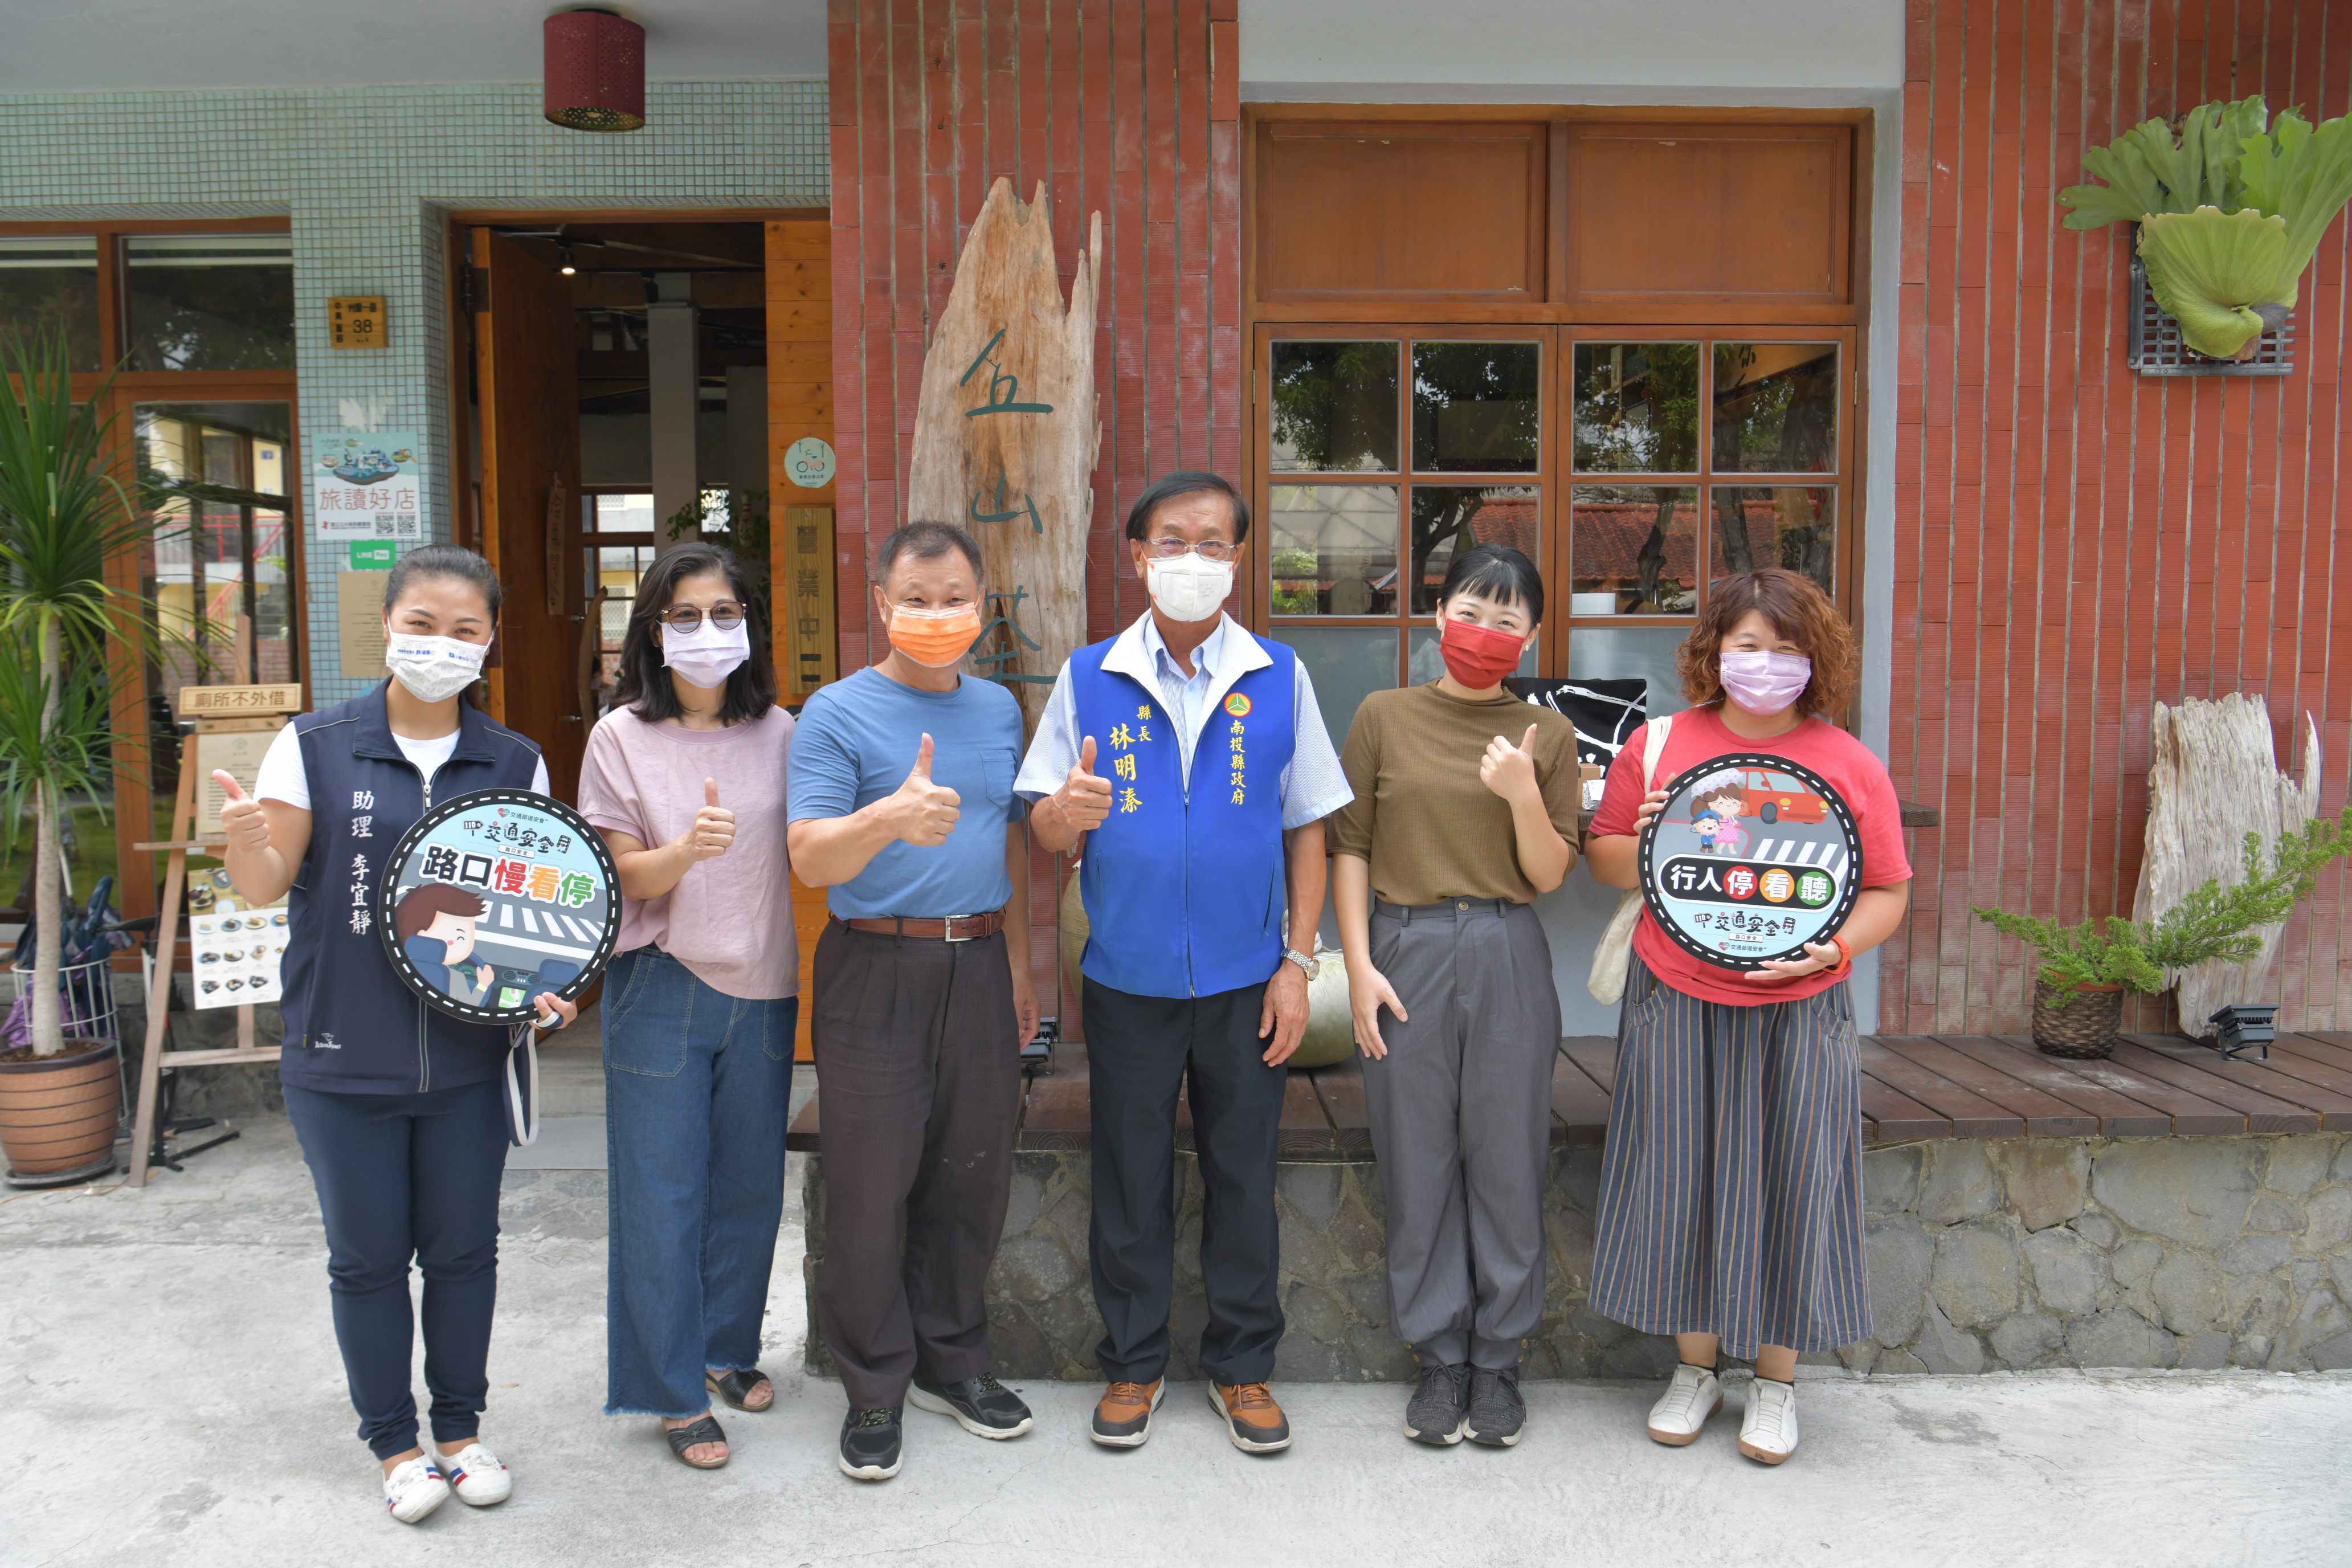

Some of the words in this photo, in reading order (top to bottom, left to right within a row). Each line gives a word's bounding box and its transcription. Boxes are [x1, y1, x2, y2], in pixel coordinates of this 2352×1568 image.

[353, 319, 372, 333] 38
[319, 487, 415, 511] 旅讀好店
[797, 525, 820, 642] 營業中
[195, 690, 286, 708] 廁所不外借
[1137, 704, 1153, 742] 縣長
[1109, 722, 1143, 814] 林明溱
[1230, 720, 1247, 806] 南投縣政府
[352, 790, 374, 838] 助理
[510, 811, 545, 824] 交通部道安會
[484, 822, 571, 854] 交通安全月
[505, 847, 528, 856] 路口安全
[349, 854, 372, 935] 李宜靜
[422, 846, 595, 906] 路口慢看停
[1670, 864, 1828, 901] 行人停看聽
[1715, 911, 1796, 936] 交通安全月
